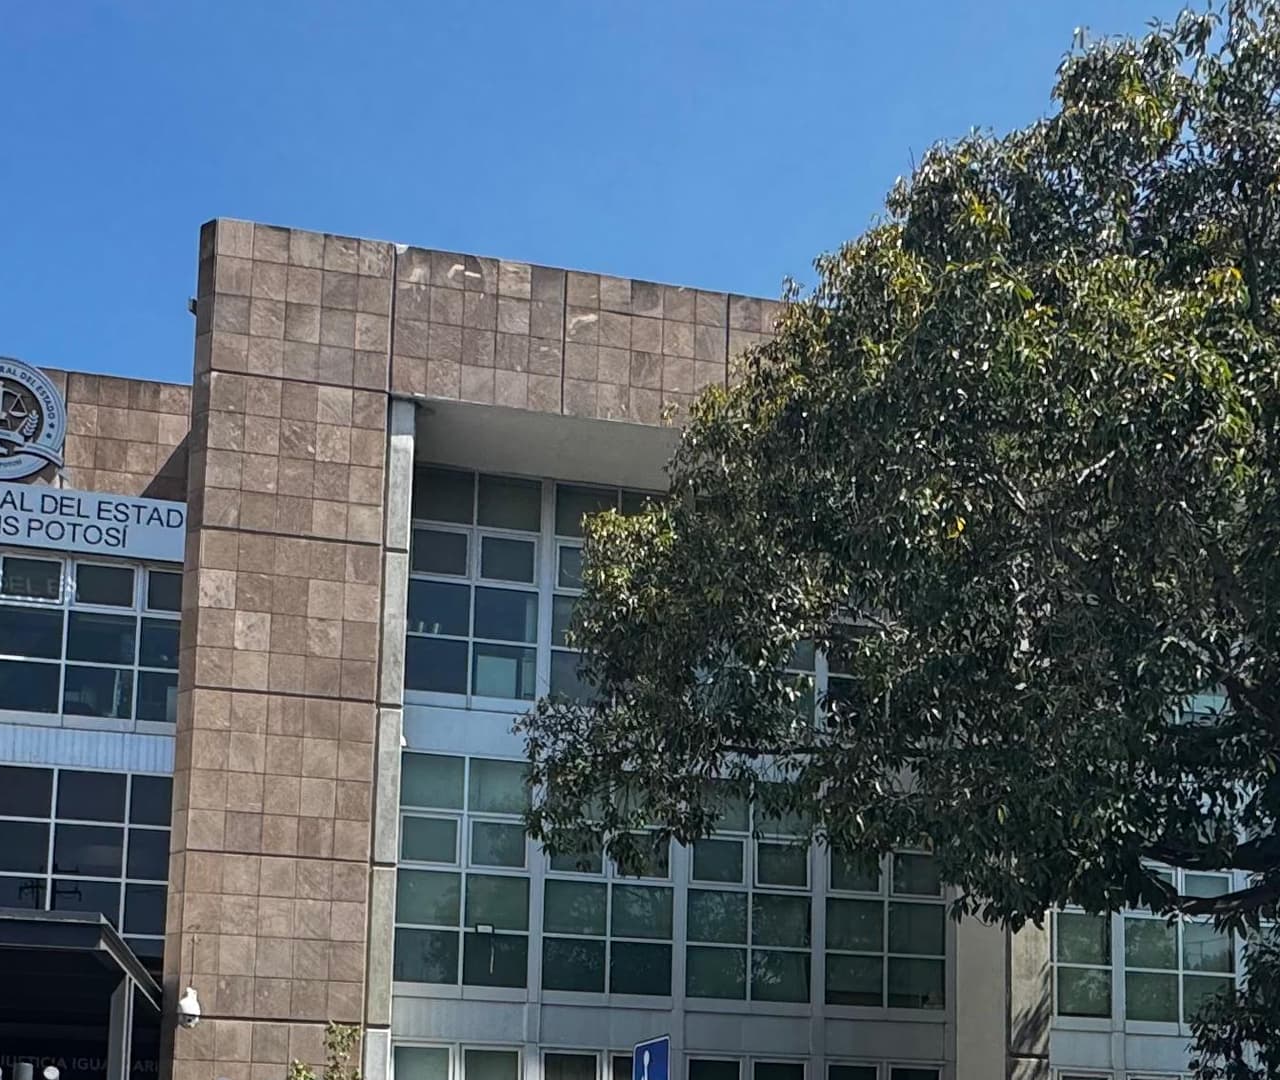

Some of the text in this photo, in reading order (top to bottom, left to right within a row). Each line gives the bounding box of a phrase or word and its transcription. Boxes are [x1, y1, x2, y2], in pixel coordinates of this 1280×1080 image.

[19, 371, 36, 387] DEL
[35, 385, 56, 421] ESTADO
[40, 493, 92, 518] DEL
[96, 500, 184, 530] ESTAD
[26, 519, 128, 549] POTOSÍ
